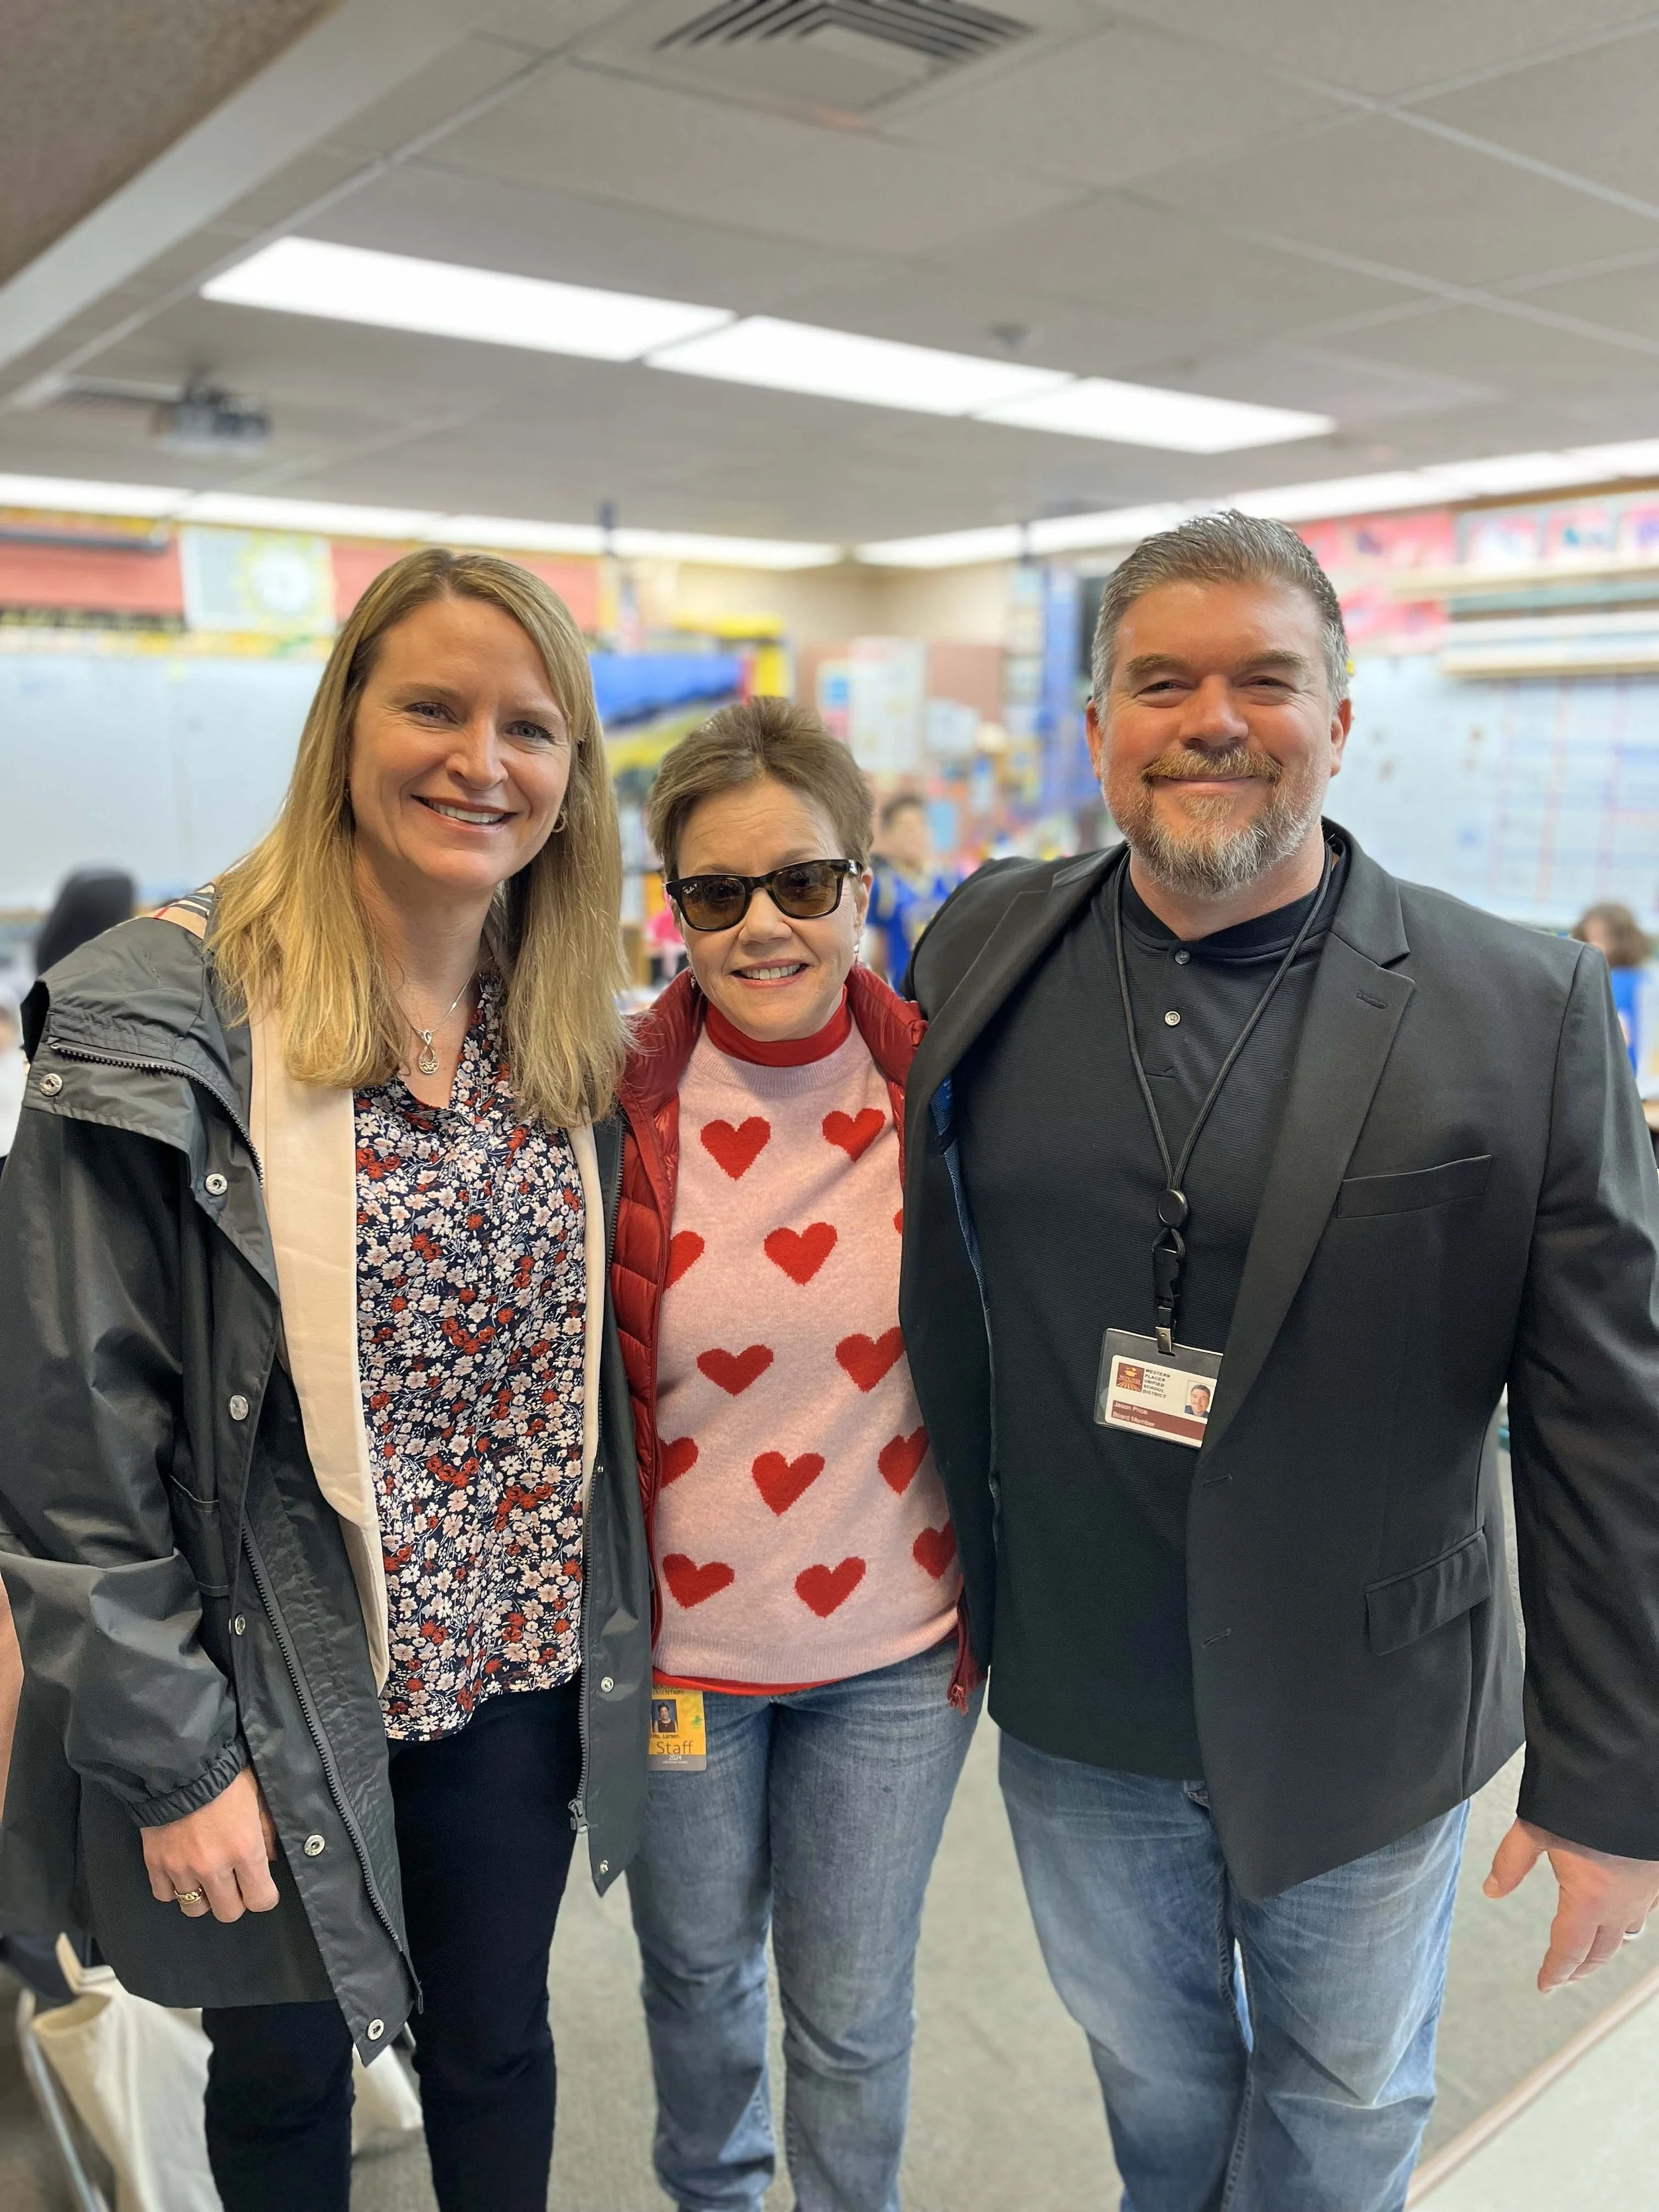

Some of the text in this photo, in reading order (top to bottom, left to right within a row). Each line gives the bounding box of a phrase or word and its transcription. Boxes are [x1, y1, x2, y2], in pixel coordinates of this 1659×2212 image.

[1145, 1369, 1170, 1378] WESTERN
[1143, 1384, 1164, 1393] SCHOOL
[1143, 1389, 1167, 1398] DISTRICT
[656, 1741, 693, 1755] Staff
